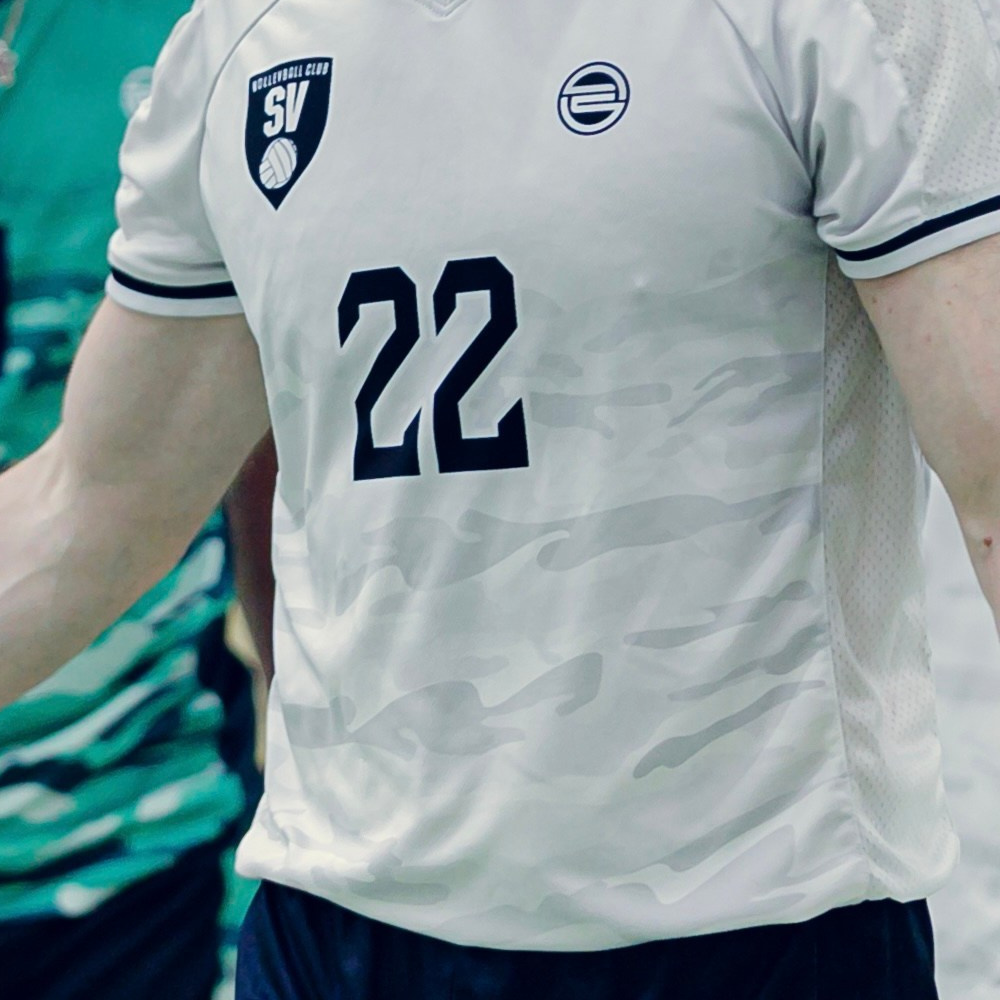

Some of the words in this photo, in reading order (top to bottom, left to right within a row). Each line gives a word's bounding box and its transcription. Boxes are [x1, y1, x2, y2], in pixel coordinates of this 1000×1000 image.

[305, 62, 330, 77] CLUB
[263, 80, 310, 137] SV
[338, 256, 529, 481] 22
